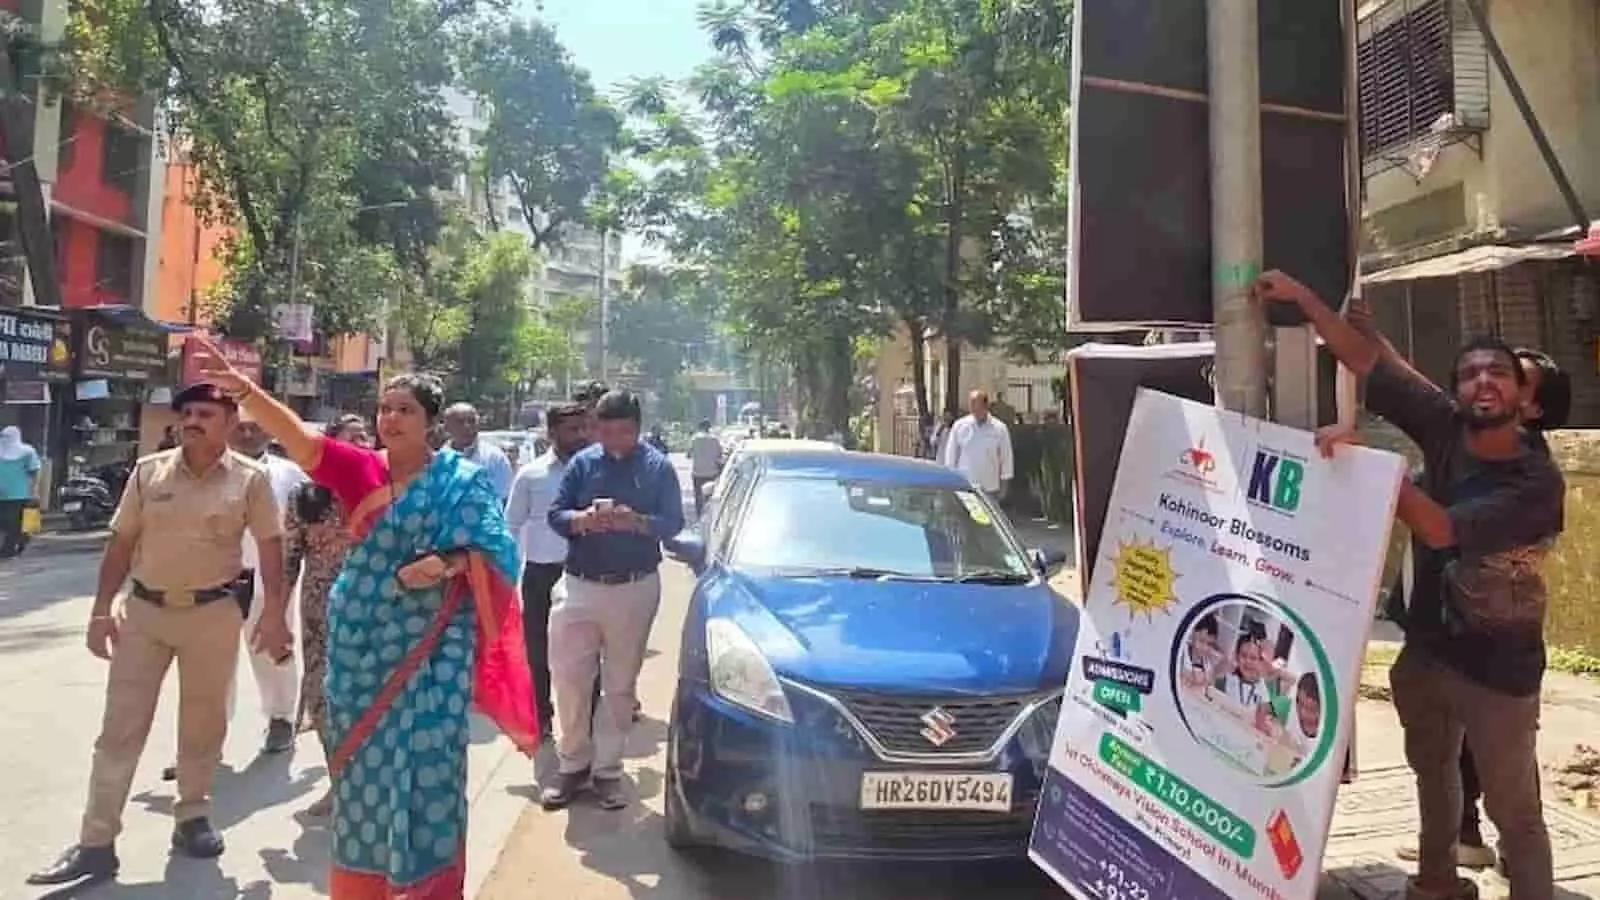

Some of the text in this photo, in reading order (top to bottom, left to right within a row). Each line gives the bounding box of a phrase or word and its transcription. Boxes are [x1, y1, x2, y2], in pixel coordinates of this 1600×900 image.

[1247, 451, 1305, 512] KB
[1159, 491, 1227, 529] Kohinoor
[1229, 517, 1312, 562] Blossoms
[1172, 817, 1216, 858] School
